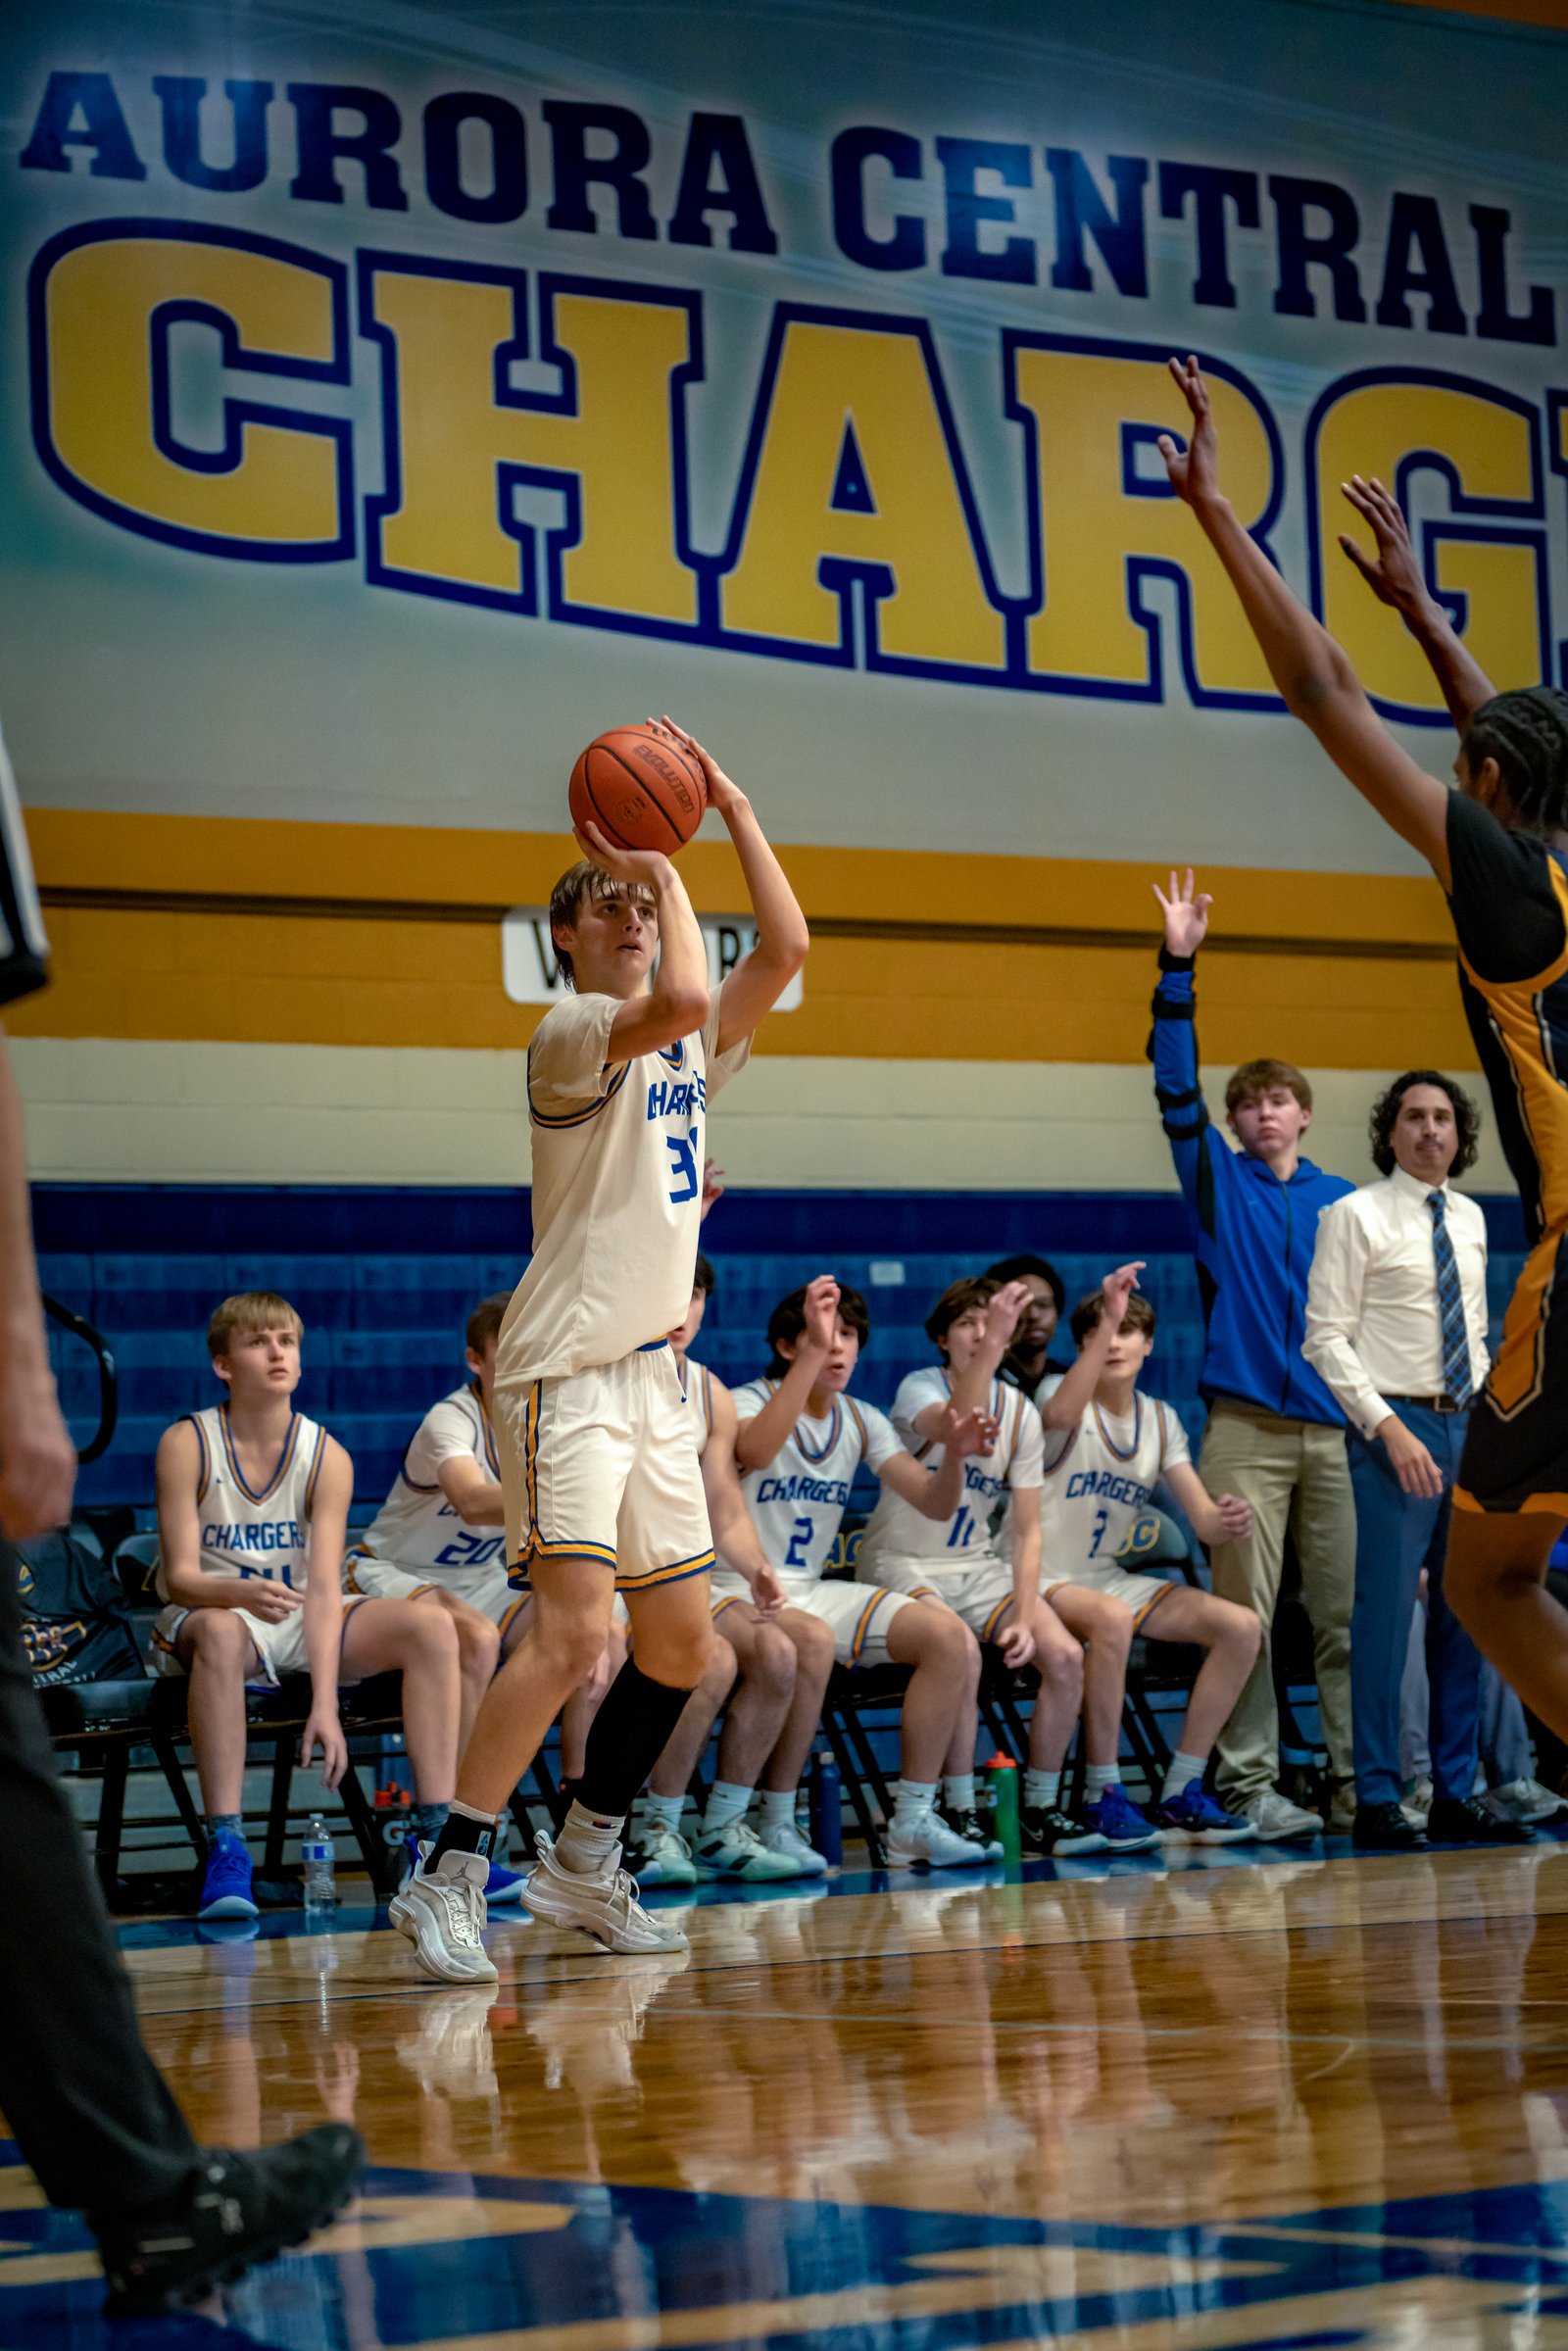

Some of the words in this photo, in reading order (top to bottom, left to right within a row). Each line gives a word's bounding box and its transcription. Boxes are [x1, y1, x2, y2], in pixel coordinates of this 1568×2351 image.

[19, 70, 779, 255] AURORA
[830, 125, 1558, 348] CENTRAL
[26, 216, 1568, 727] CHARG
[434, 1531, 506, 1565] 20
[784, 1516, 815, 1567] 2
